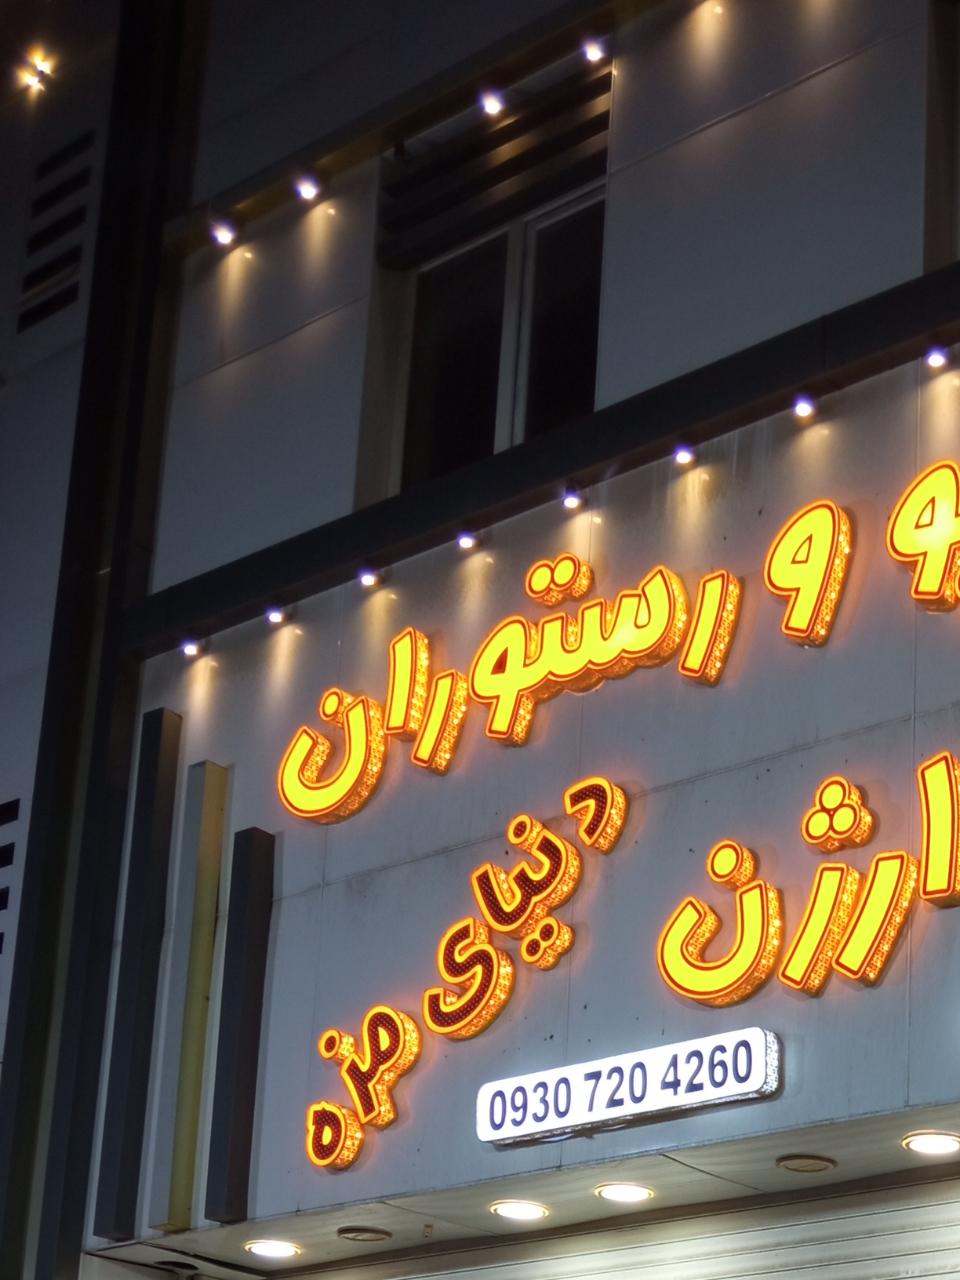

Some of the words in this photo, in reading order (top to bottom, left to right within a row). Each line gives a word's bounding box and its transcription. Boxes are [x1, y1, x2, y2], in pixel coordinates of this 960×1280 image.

[766, 500, 853, 646] و
[279, 553, 743, 822] رستوران
[423, 777, 629, 1038] دنیای
[306, 1005, 420, 1169] مزه
[488, 1076, 572, 1131] 0930
[583, 1061, 648, 1108] 720
[660, 1038, 754, 1096] 4260
